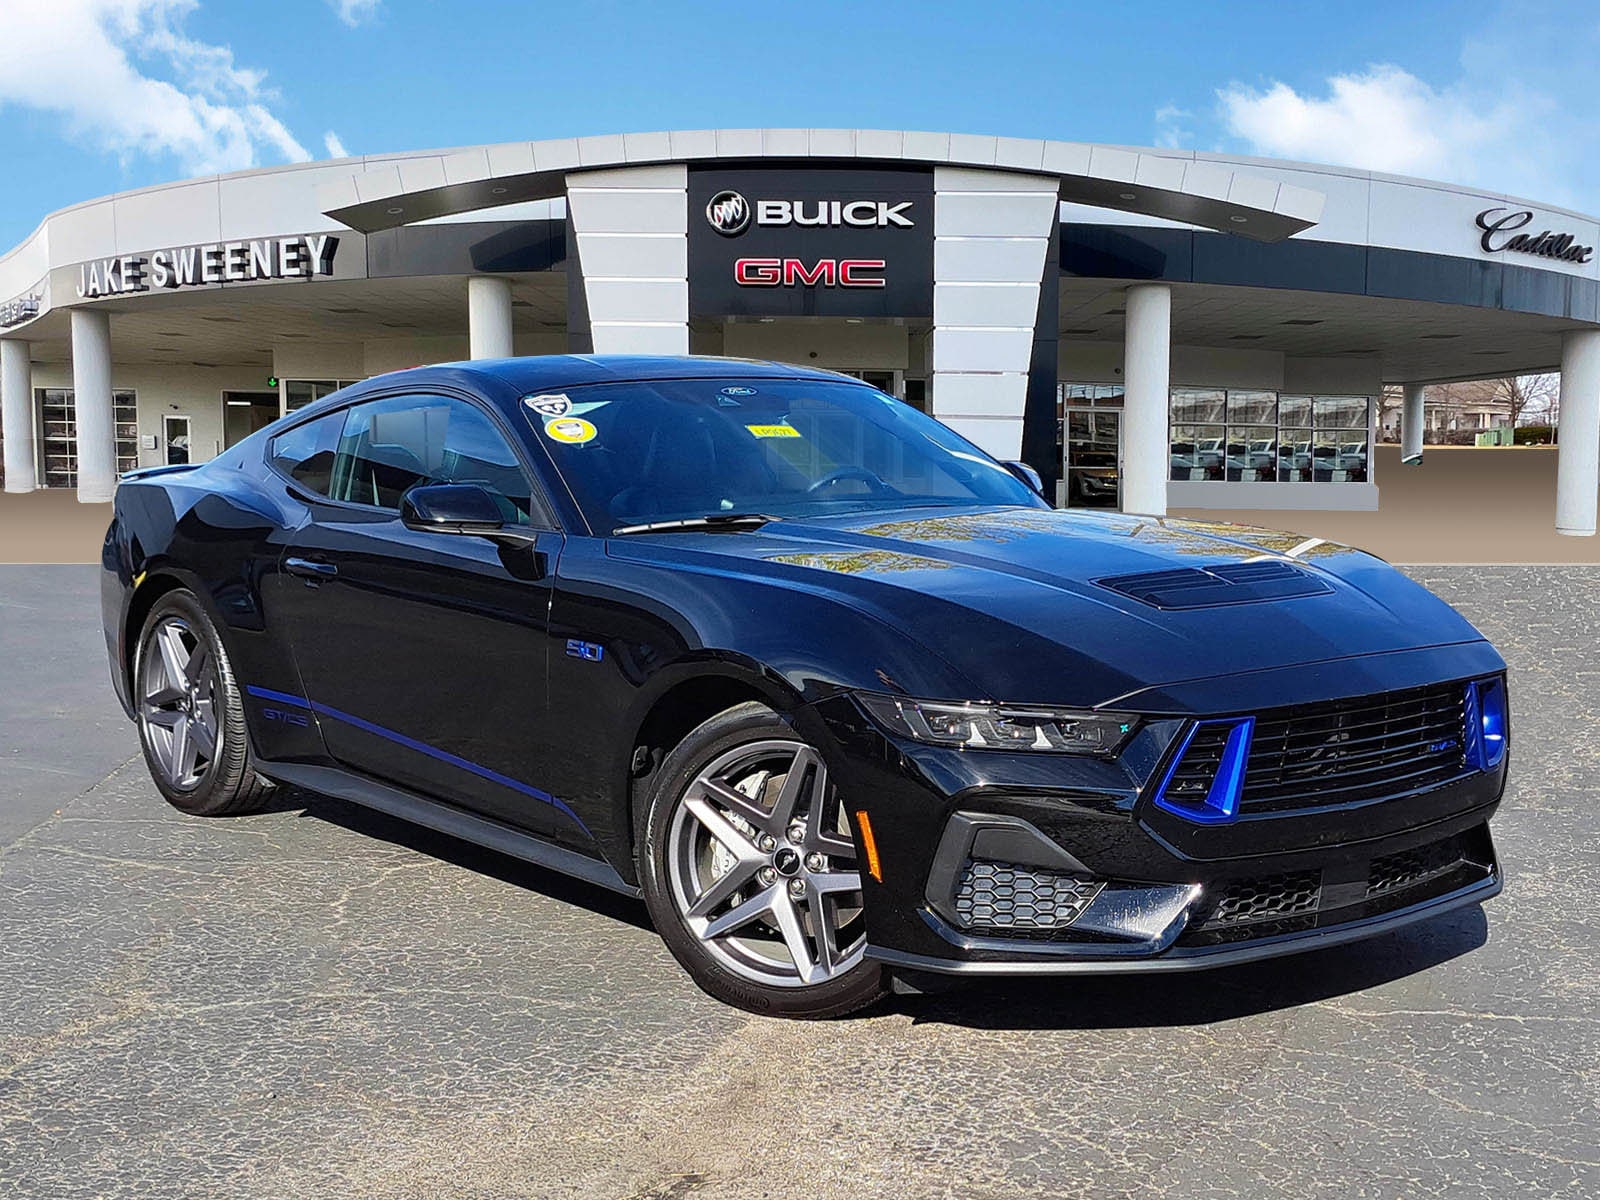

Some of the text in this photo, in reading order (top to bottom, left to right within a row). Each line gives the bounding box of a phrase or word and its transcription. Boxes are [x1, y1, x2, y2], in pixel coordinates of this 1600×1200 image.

[757, 201, 914, 226] BUICK
[1475, 208, 1593, 263] Cadillac
[76, 235, 331, 297] JAKE SWEENEY
[735, 258, 885, 286] GMC
